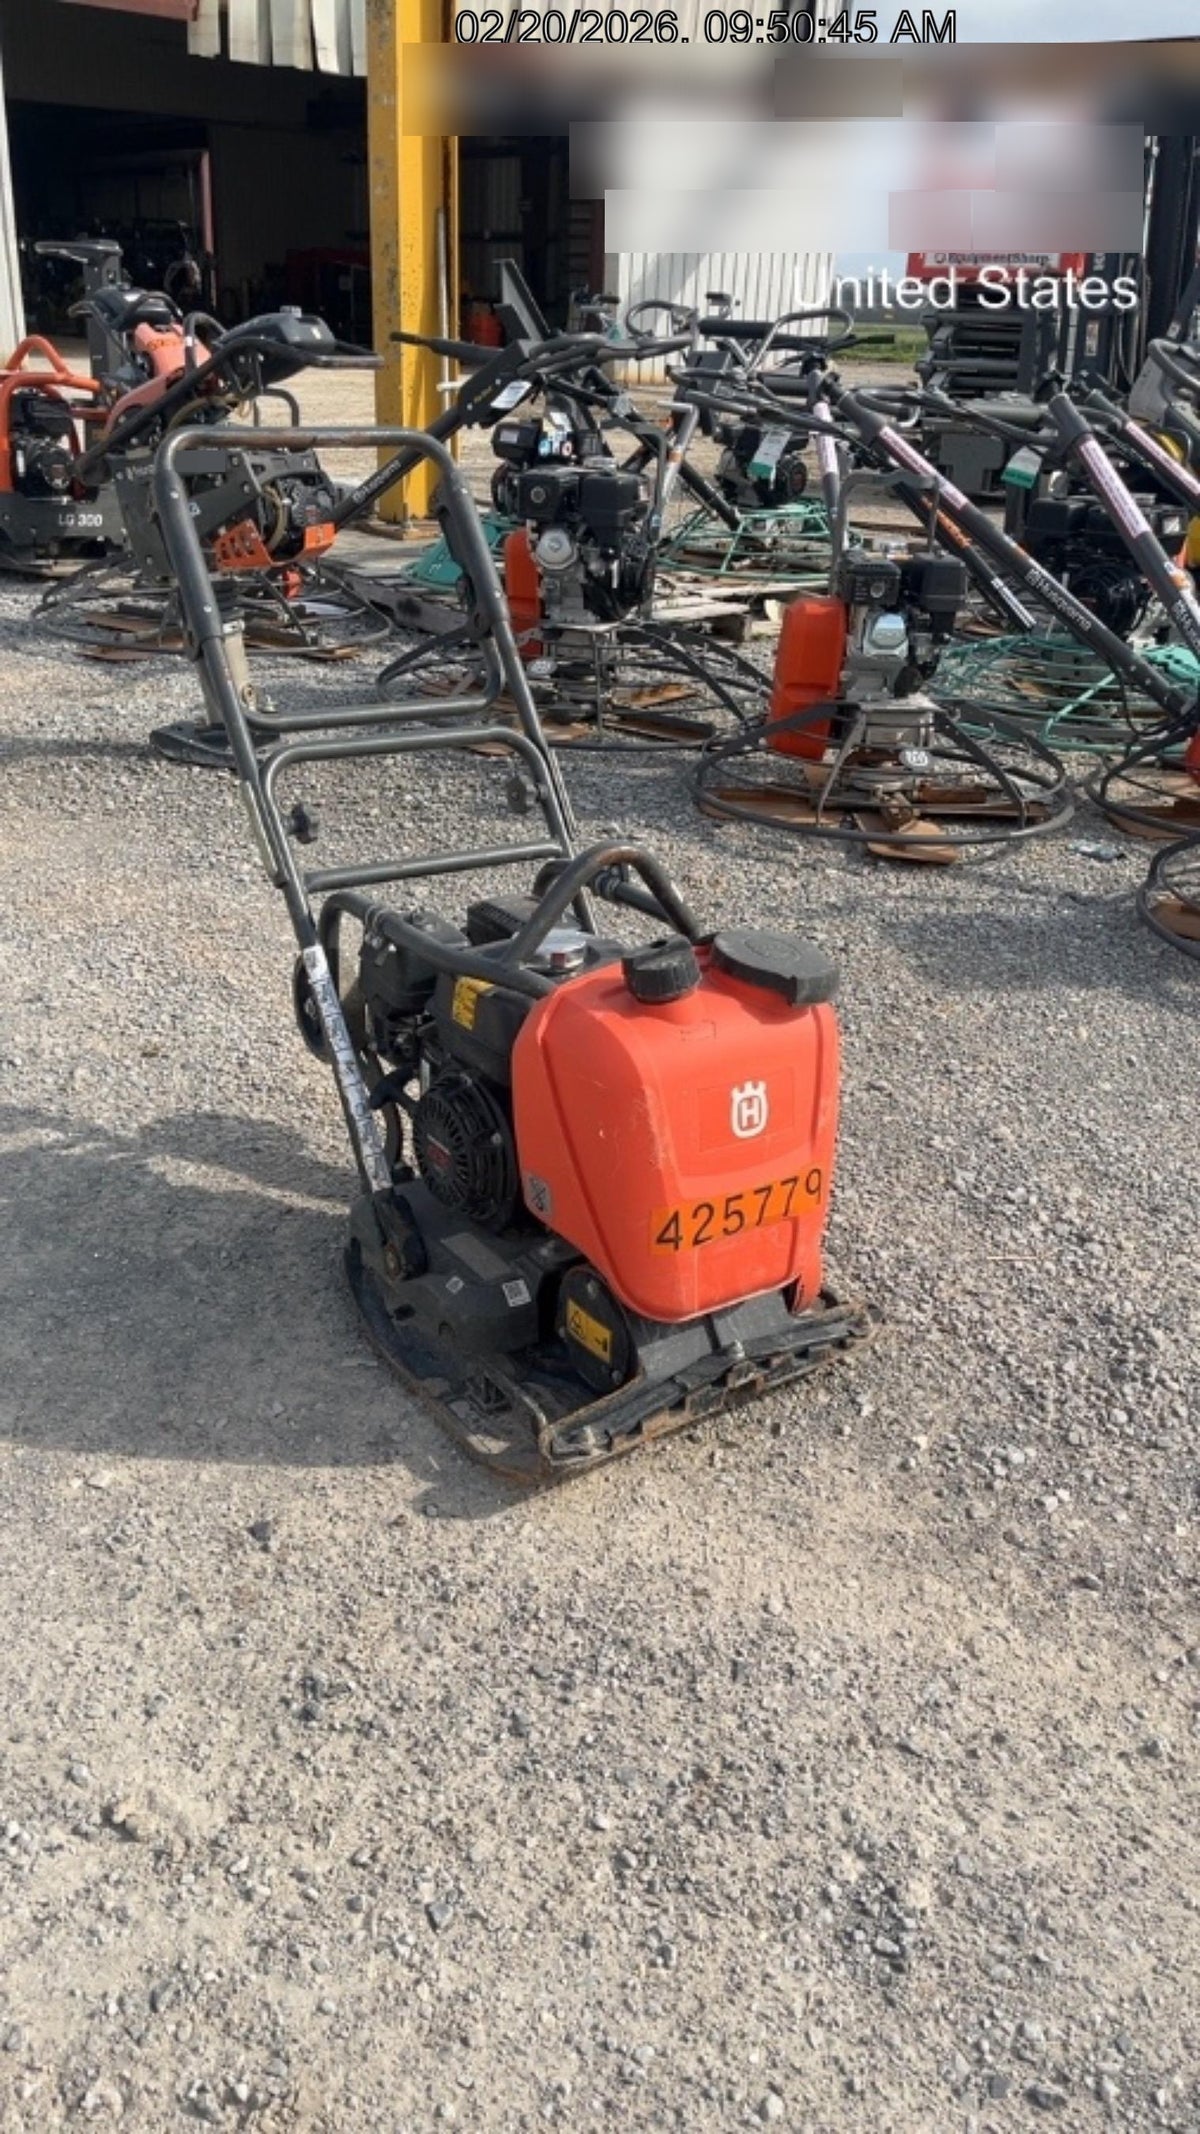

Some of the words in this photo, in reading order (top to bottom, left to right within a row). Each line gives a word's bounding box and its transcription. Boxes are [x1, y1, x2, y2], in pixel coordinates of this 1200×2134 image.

[58, 513, 75, 527] LG
[78, 513, 103, 528] 300
[655, 1168, 822, 1252] 425779
